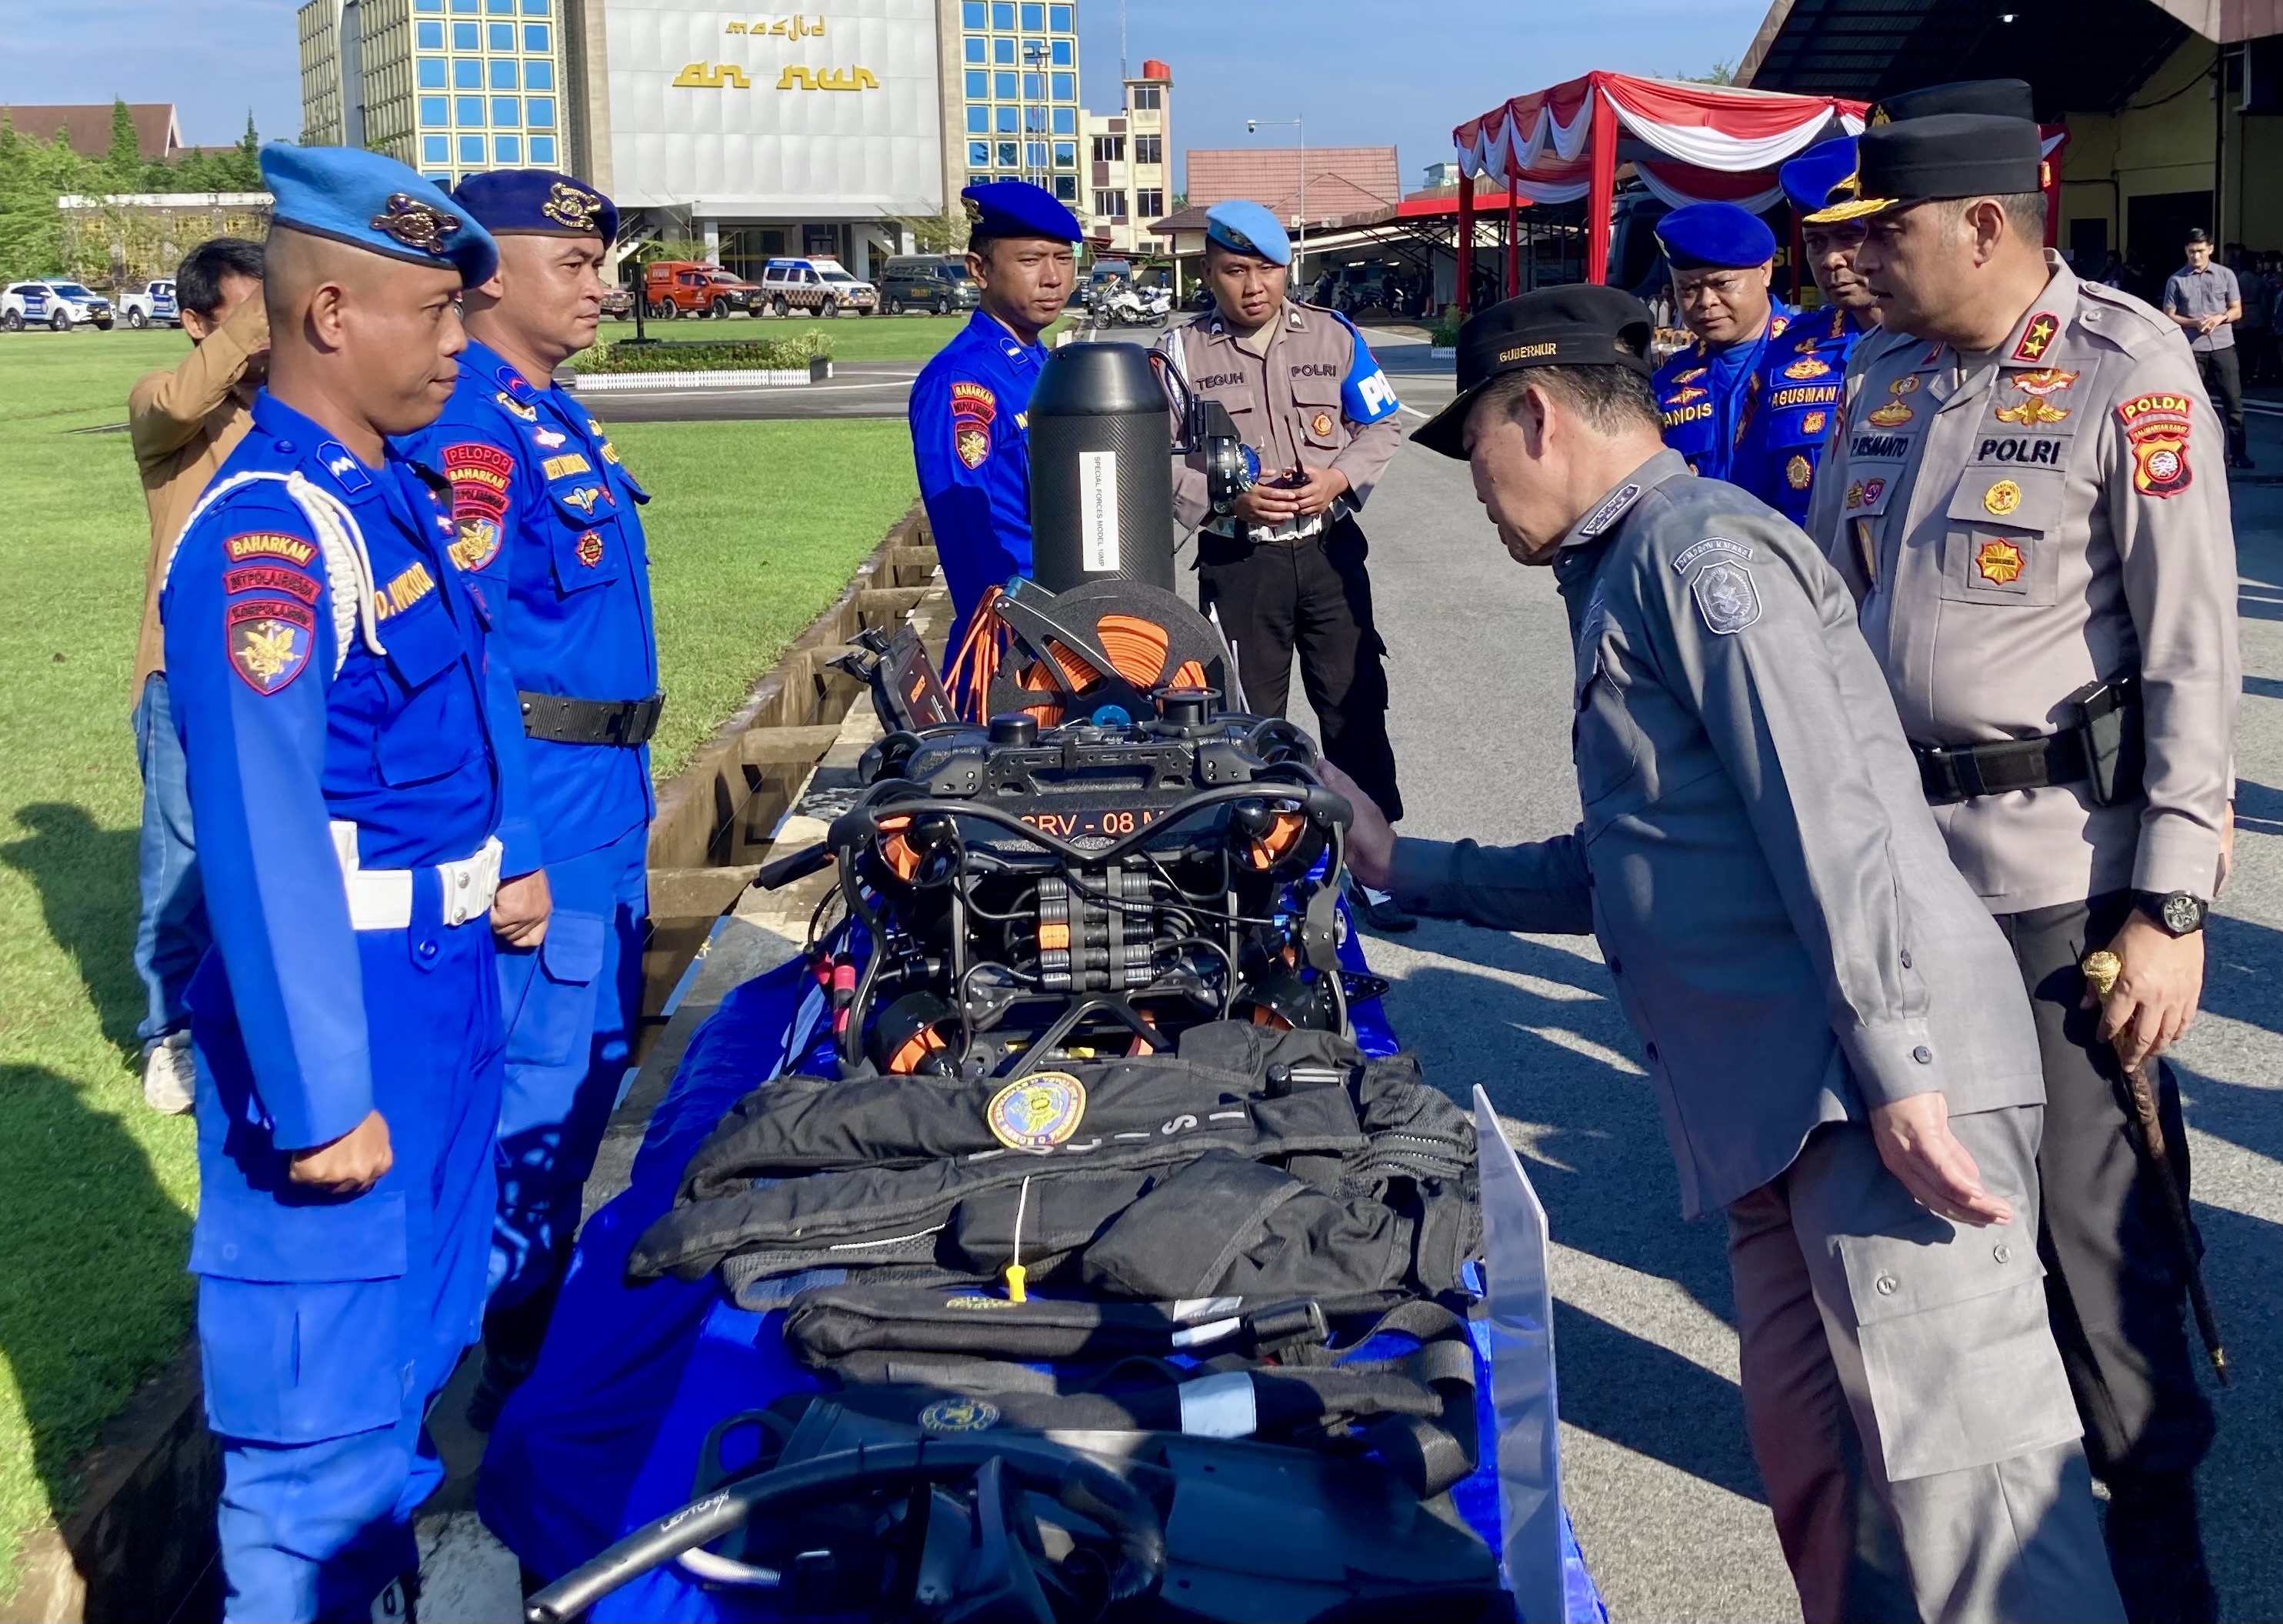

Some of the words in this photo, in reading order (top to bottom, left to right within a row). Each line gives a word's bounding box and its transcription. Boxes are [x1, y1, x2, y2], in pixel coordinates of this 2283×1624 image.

[1499, 342, 1557, 362] GUBERNUR
[1195, 372, 1245, 391] TEGUH
[1291, 364, 1337, 378] POLRI
[955, 384, 994, 405] BAHARKAM
[1771, 386, 1837, 409] AGUSMAN
[2125, 396, 2187, 419] POLDA
[449, 446, 509, 470] PELOPOR
[1978, 439, 2061, 465] POLRI
[449, 468, 505, 489] BAHARKAM
[232, 535, 312, 562] BAHARKAM
[1102, 812, 1135, 834] 08
